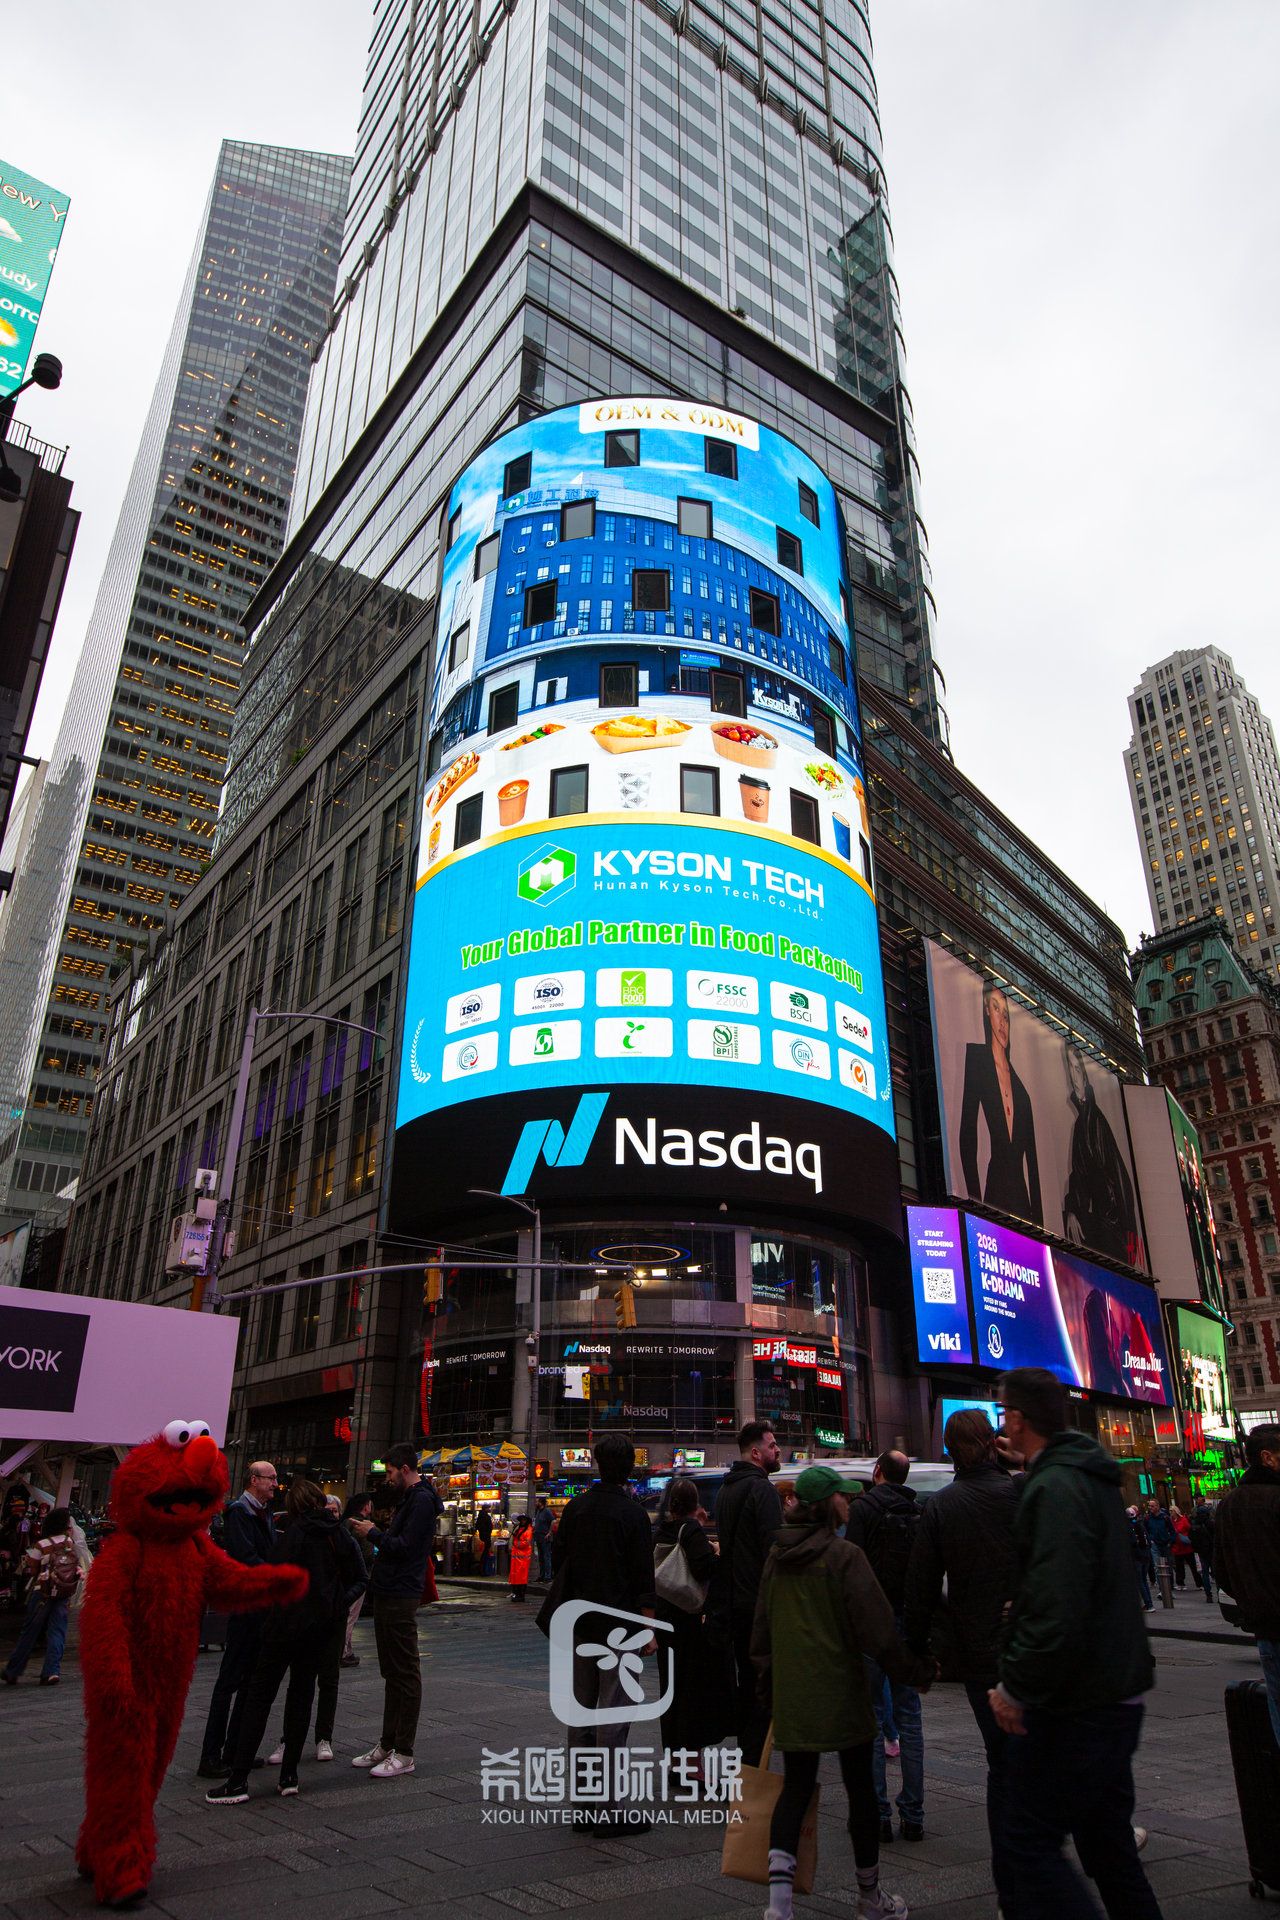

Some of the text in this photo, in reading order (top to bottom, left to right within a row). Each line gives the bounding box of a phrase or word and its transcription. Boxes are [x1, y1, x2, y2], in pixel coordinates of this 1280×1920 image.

[0, 265, 38, 292] udy
[594, 405, 744, 437] OEM & ODM
[593, 850, 825, 908] KYSON TECH
[594, 881, 648, 891] Hunan
[659, 881, 713, 894] Kyson
[461, 920, 863, 994] Your Global Partner in Food Packaging
[535, 987, 561, 999] ISO
[622, 986, 645, 994] BRC
[717, 984, 747, 997] FSSC
[461, 1002, 481, 1016] ISO
[716, 996, 749, 1009] 22000
[790, 1008, 812, 1023] BSCI
[842, 1015, 867, 1039] Sedex
[797, 1050, 810, 1060] DIN
[615, 1117, 823, 1194] Nasdaq
[924, 1230, 943, 1238] START
[917, 1240, 954, 1248] STREAMING
[976, 1233, 998, 1252] 2026
[979, 1251, 1041, 1288] FAN FAVORITE
[981, 1272, 1025, 1302] K-DRAMA
[928, 1332, 961, 1350] Viki
[578, 1344, 716, 1355] Nasdaq REWRITE TOMORROW
[446, 1351, 506, 1365] REWRITE TOMORROW
[1122, 1350, 1147, 1370] Dream
[1149, 1352, 1165, 1373] You
[623, 1405, 669, 1420] Nasdaq
